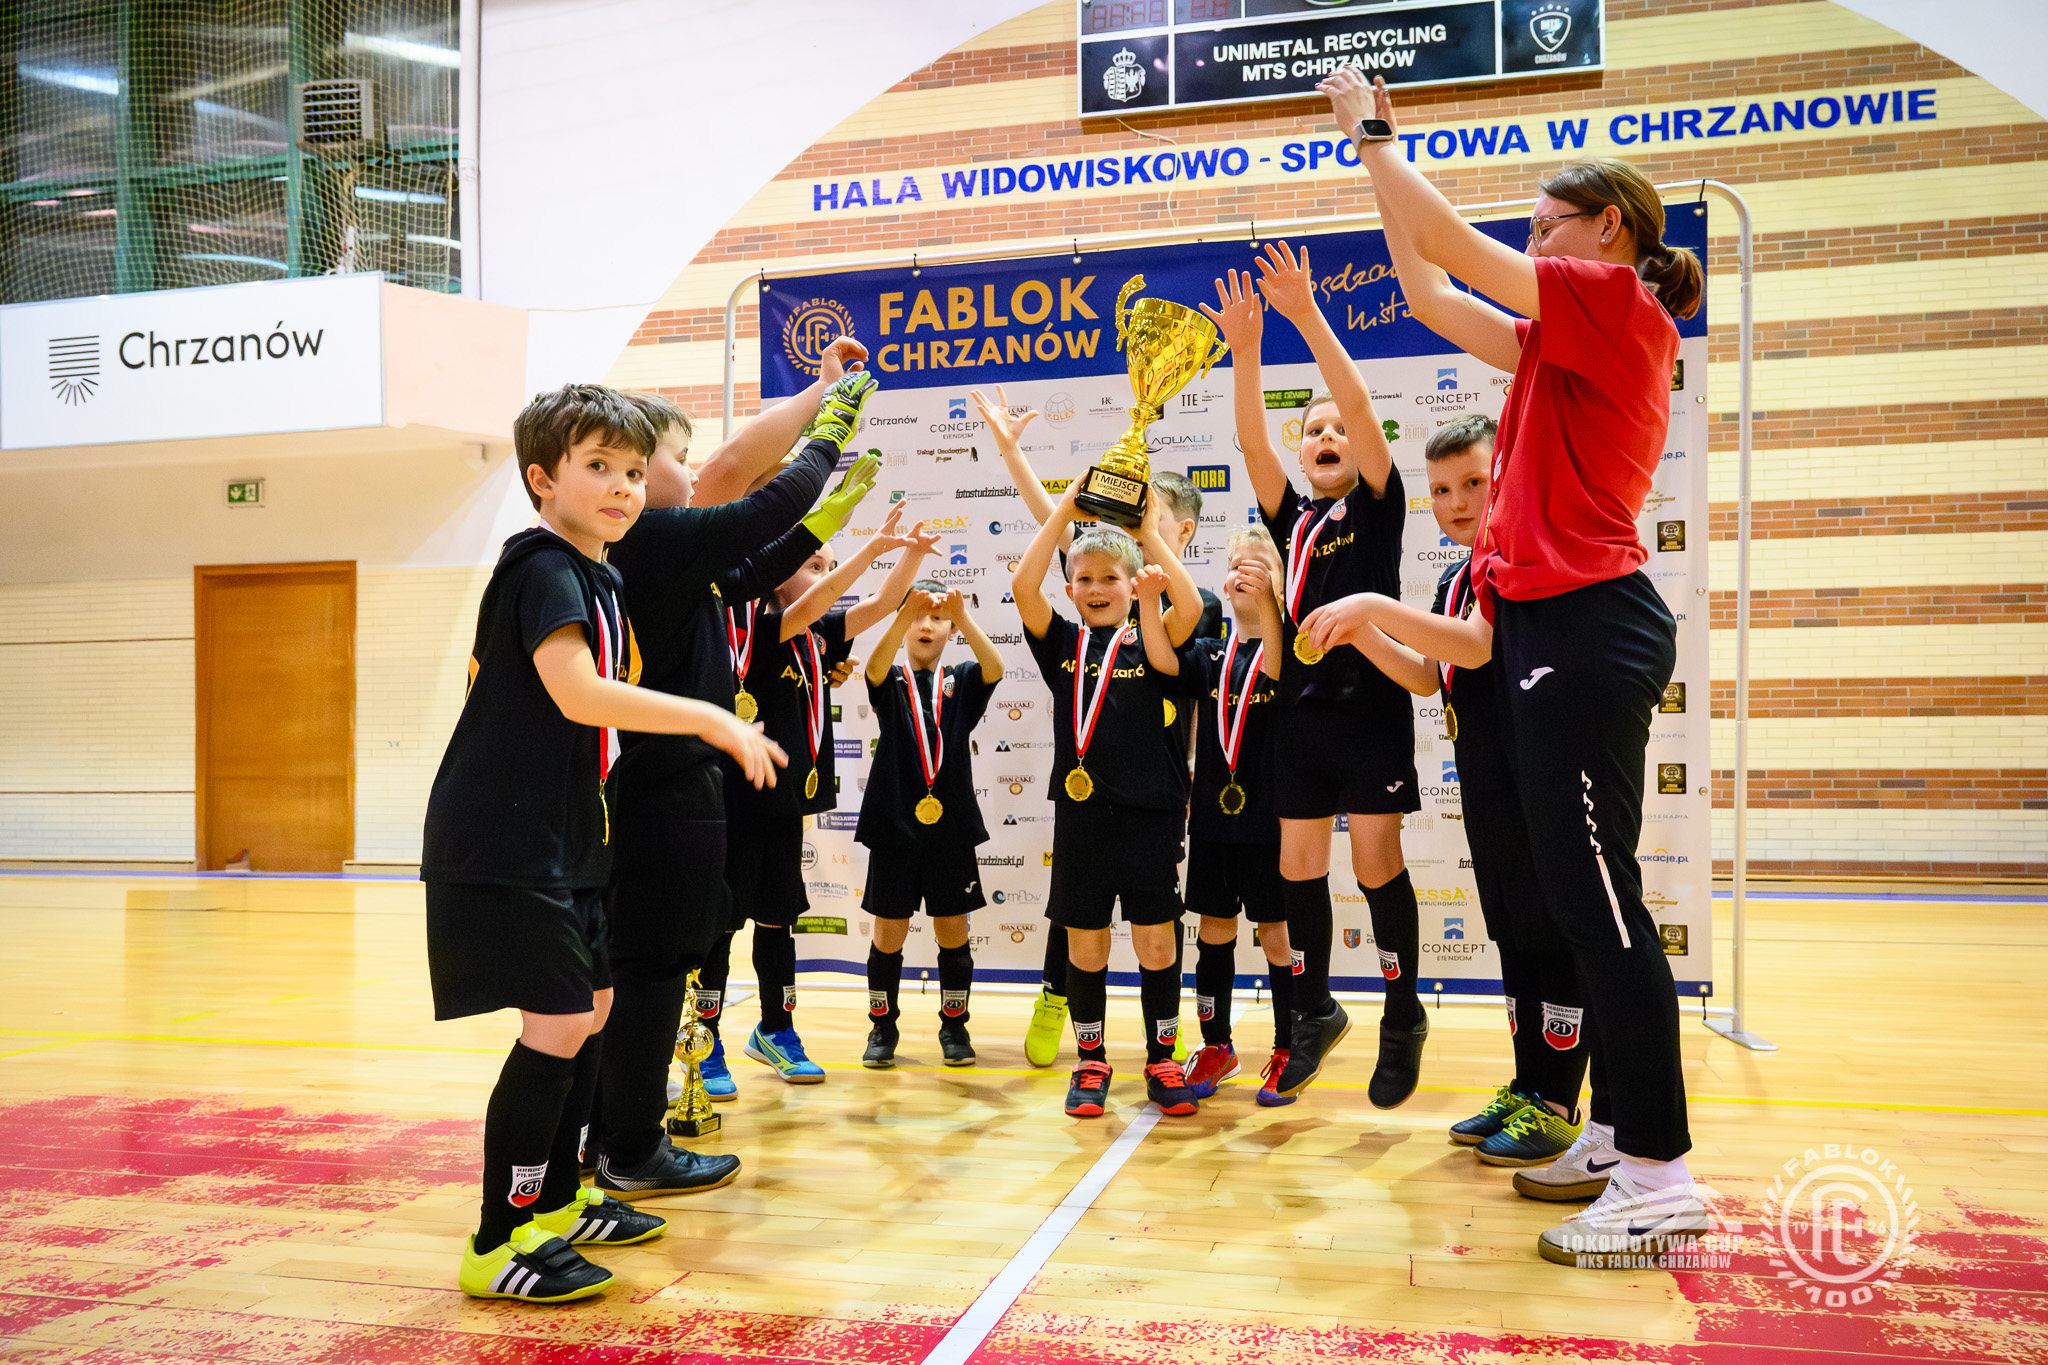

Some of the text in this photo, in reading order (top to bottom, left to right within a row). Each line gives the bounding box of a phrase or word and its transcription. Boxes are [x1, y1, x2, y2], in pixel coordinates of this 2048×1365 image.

[1213, 24, 1447, 63] UNIMETAL RECYCLING
[1242, 48, 1416, 82] MTS CHRZANÓW
[813, 176, 923, 211] HALA
[941, 147, 1250, 199] WIDOWISKOWO
[1280, 124, 1532, 172] SPOTOWA
[1547, 118, 1589, 150] W
[1609, 89, 1938, 145] CHRZANOWIE
[792, 298, 846, 316] FABLOK
[879, 275, 1099, 335] FABLOK
[119, 320, 325, 370] Chrzanów
[877, 323, 1101, 372] CHRZANÓW
[1371, 392, 1403, 400] zanowski
[1415, 393, 1481, 406] CONCEPT
[1430, 405, 1466, 413] EIENDOM
[869, 415, 918, 427] Chrzanów
[929, 421, 987, 433] CONCEPT
[1100, 474, 1139, 493] MIEJSCE
[954, 486, 1021, 499] fotostudzinski.p
[931, 568, 988, 579] CONCEPT
[1420, 786, 1460, 796] CONC
[977, 855, 1025, 868] tudzinski.pl
[1421, 943, 1487, 954] CONCEPT
[1553, 1022, 1567, 1034] 21
[525, 1181, 540, 1193] 21
